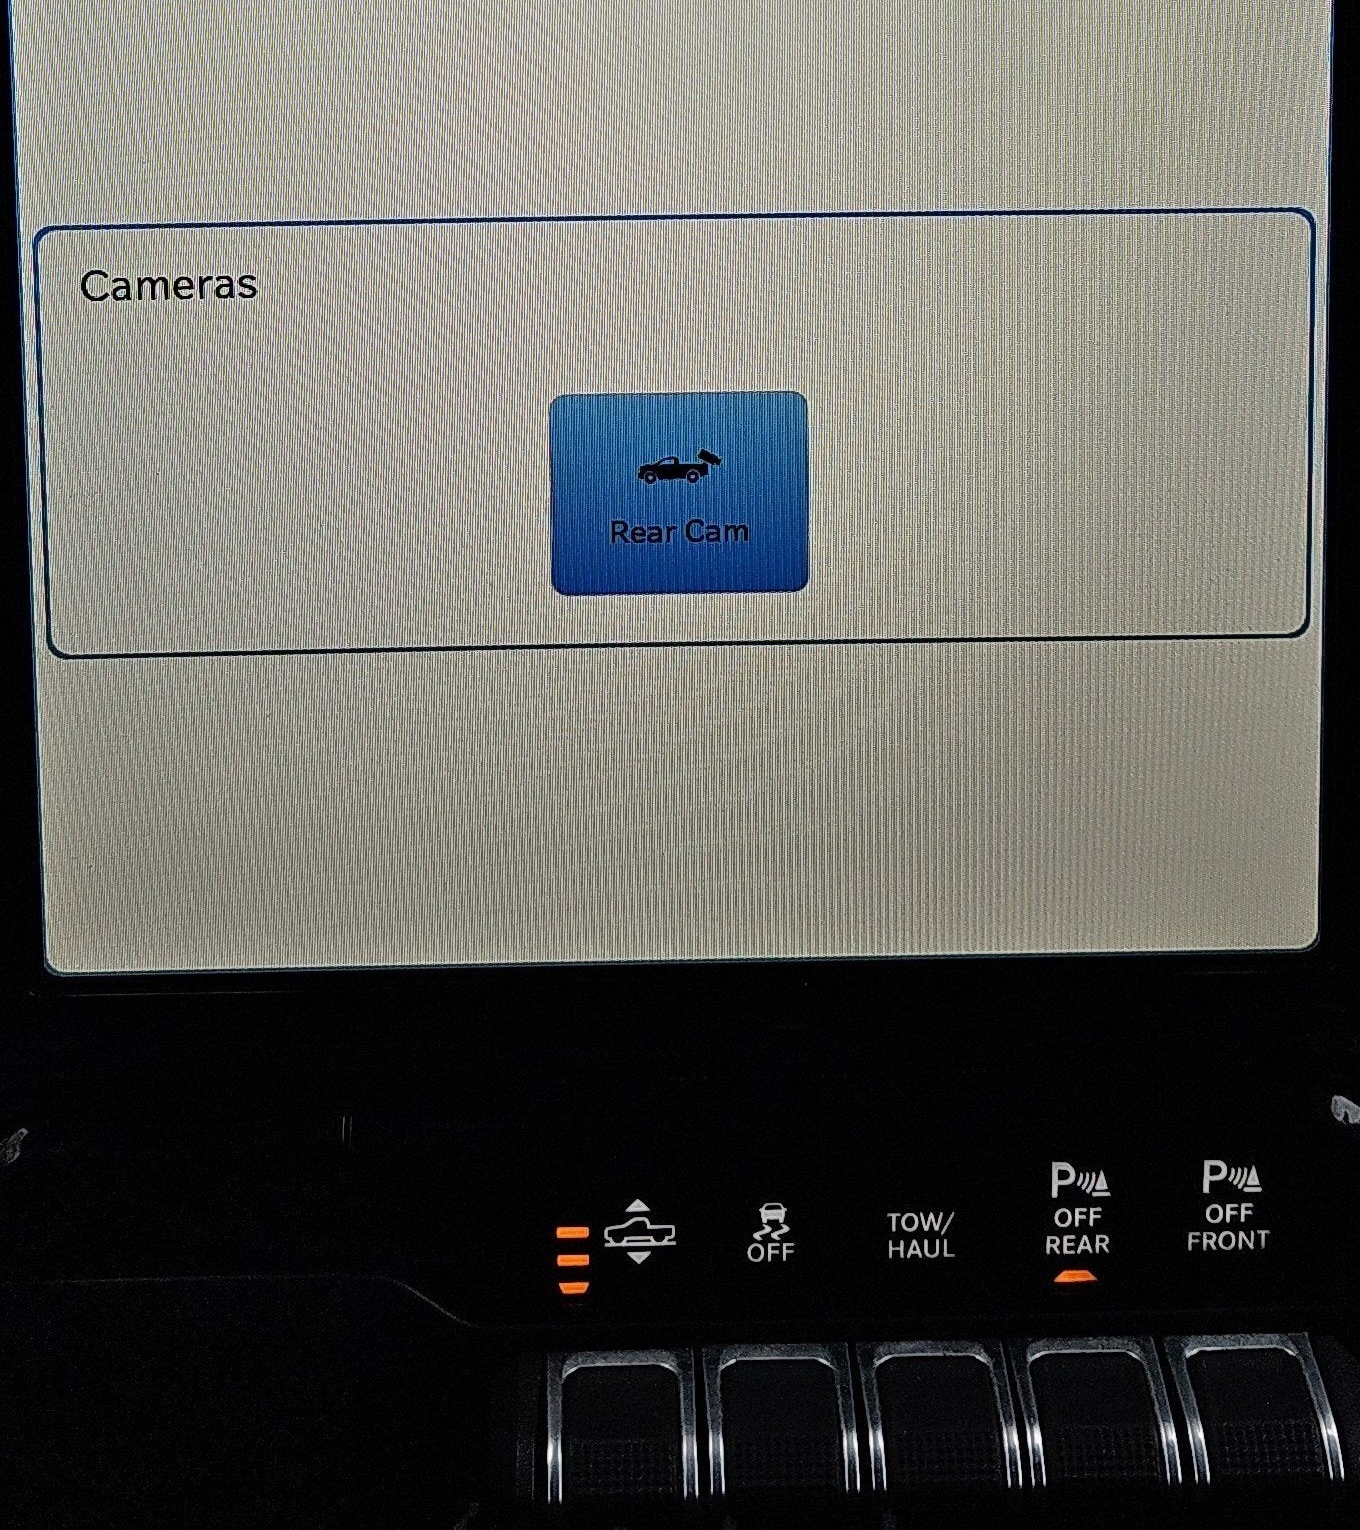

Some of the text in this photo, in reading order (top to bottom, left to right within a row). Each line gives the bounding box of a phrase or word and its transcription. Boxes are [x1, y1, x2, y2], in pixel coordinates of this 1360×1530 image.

[80, 269, 258, 302] Cameras
[610, 518, 749, 544] Rear Cam
[887, 1211, 955, 1236] TOW/
[1054, 1207, 1103, 1228] OFF
[1205, 1202, 1255, 1224] OFF
[888, 1238, 956, 1259] HAUL
[1045, 1233, 1111, 1255] REAR
[1187, 1229, 1271, 1252] FRONT
[747, 1242, 795, 1263] OFF
